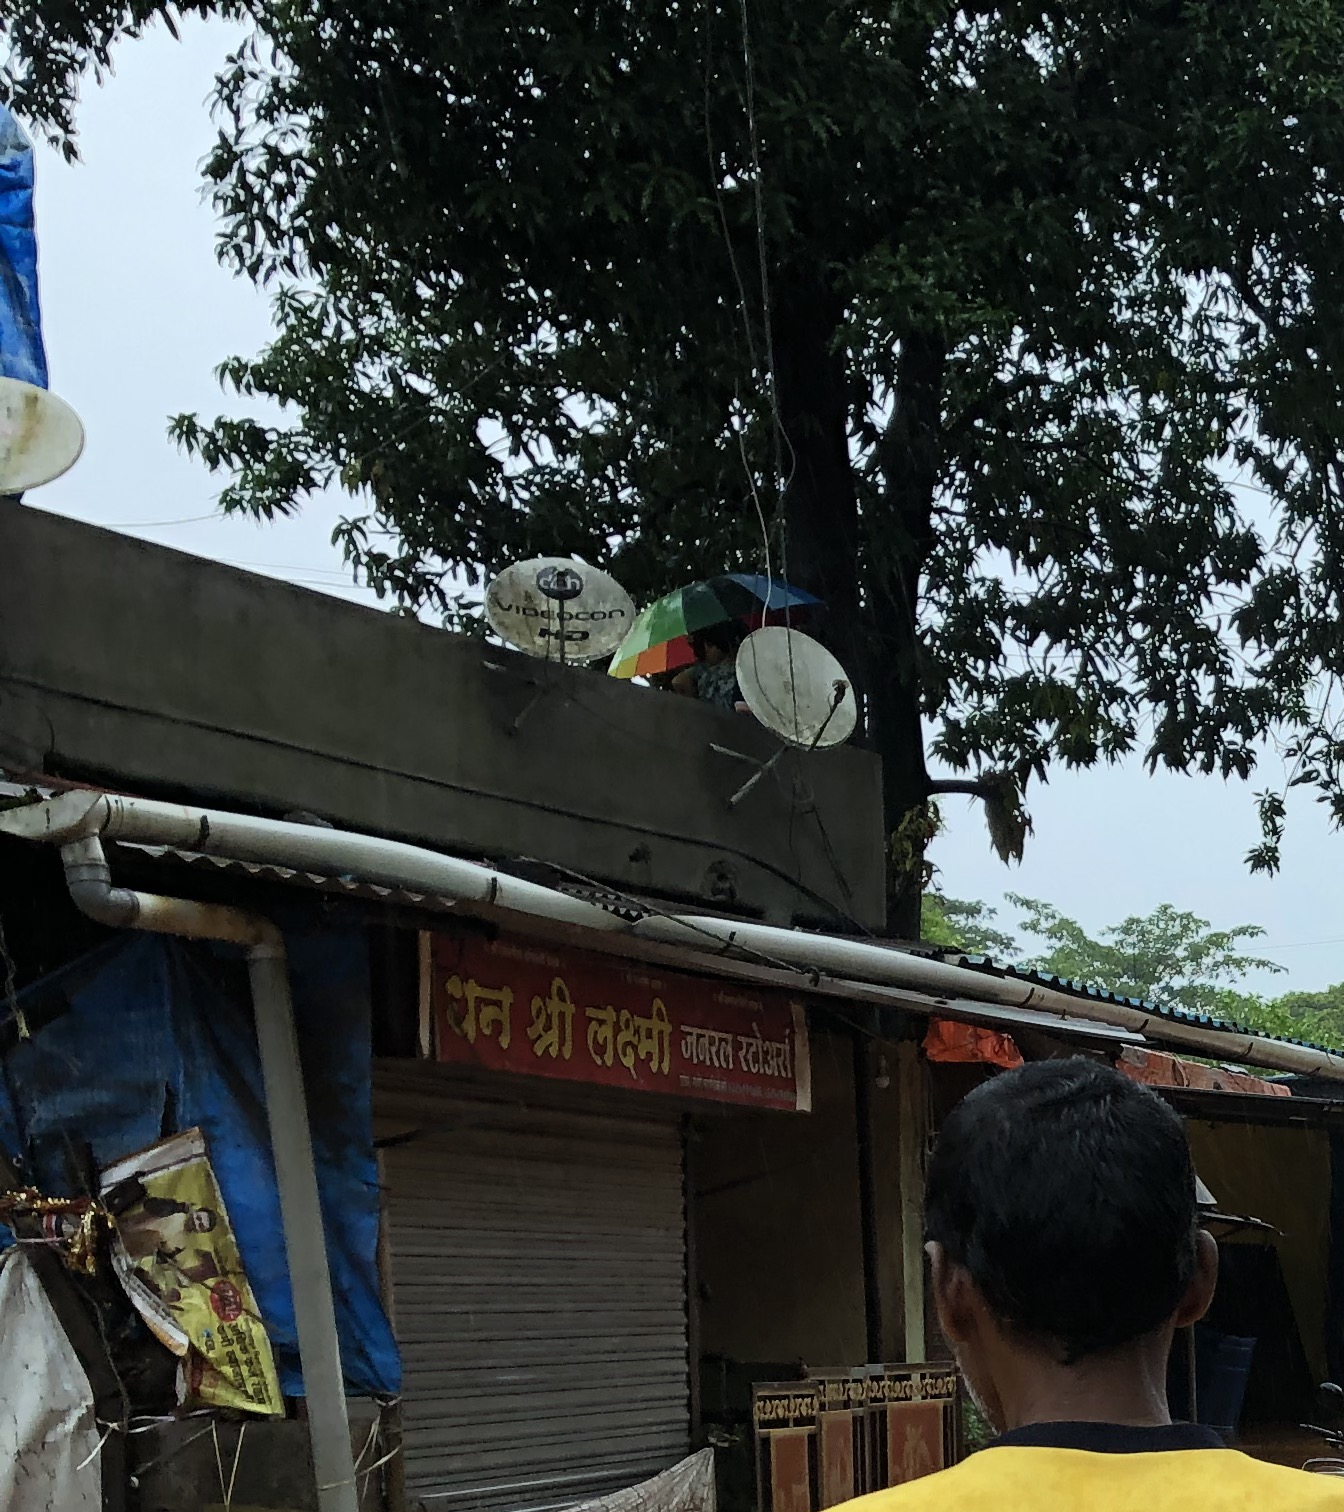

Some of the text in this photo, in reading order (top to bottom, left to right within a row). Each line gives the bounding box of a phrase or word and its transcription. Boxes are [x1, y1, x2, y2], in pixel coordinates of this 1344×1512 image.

[527, 977, 576, 1060] श्री
[585, 997, 673, 1080] लक्ष्मी
[680, 1024, 734, 1070] जनरल
